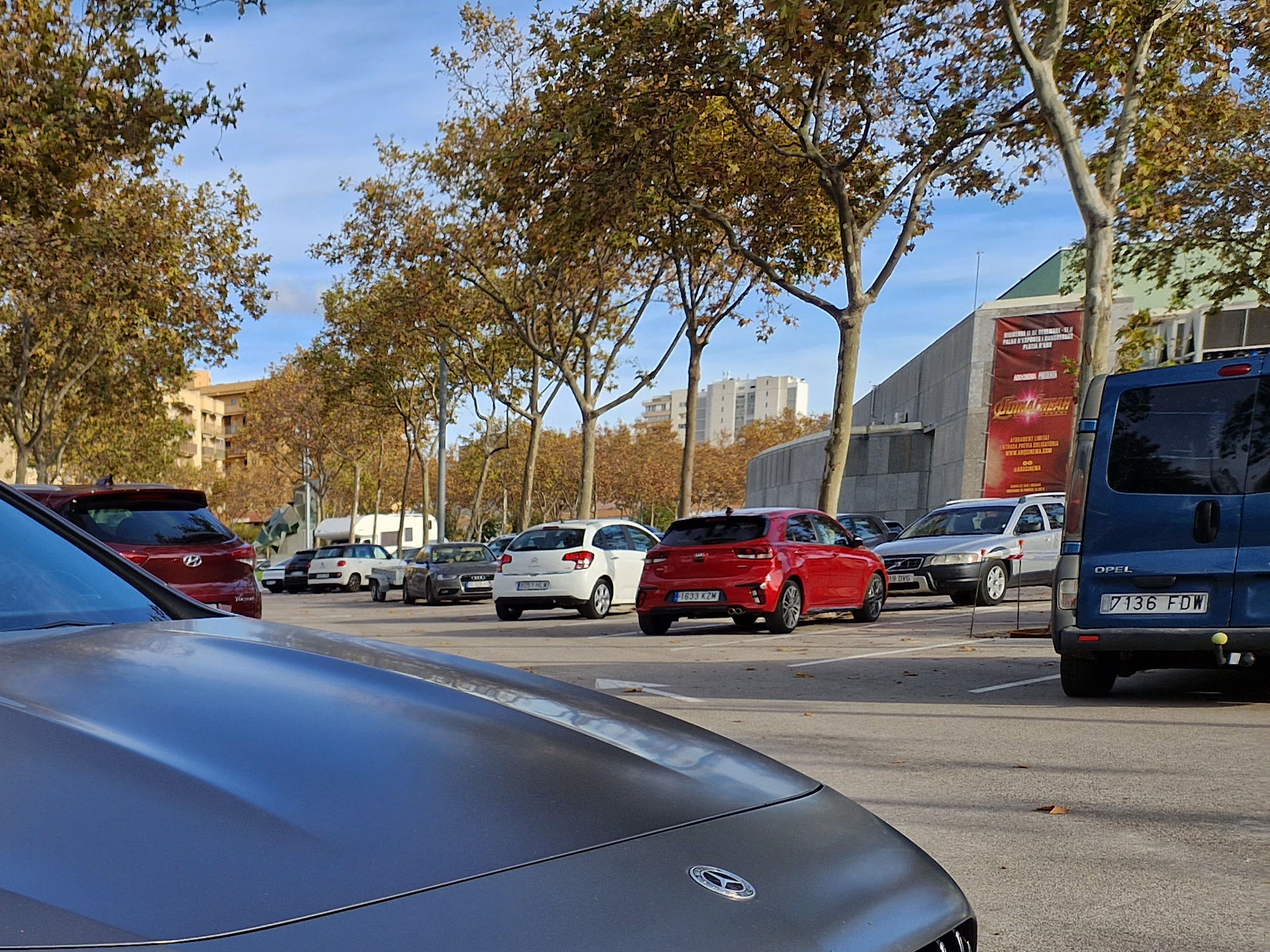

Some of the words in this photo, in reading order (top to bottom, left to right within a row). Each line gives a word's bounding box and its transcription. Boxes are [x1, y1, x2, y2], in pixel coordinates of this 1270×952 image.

[1094, 565, 1133, 574] OPEL
[681, 592, 699, 600] 1633
[1110, 595, 1157, 611] 7136
[1167, 594, 1204, 610] FDW
